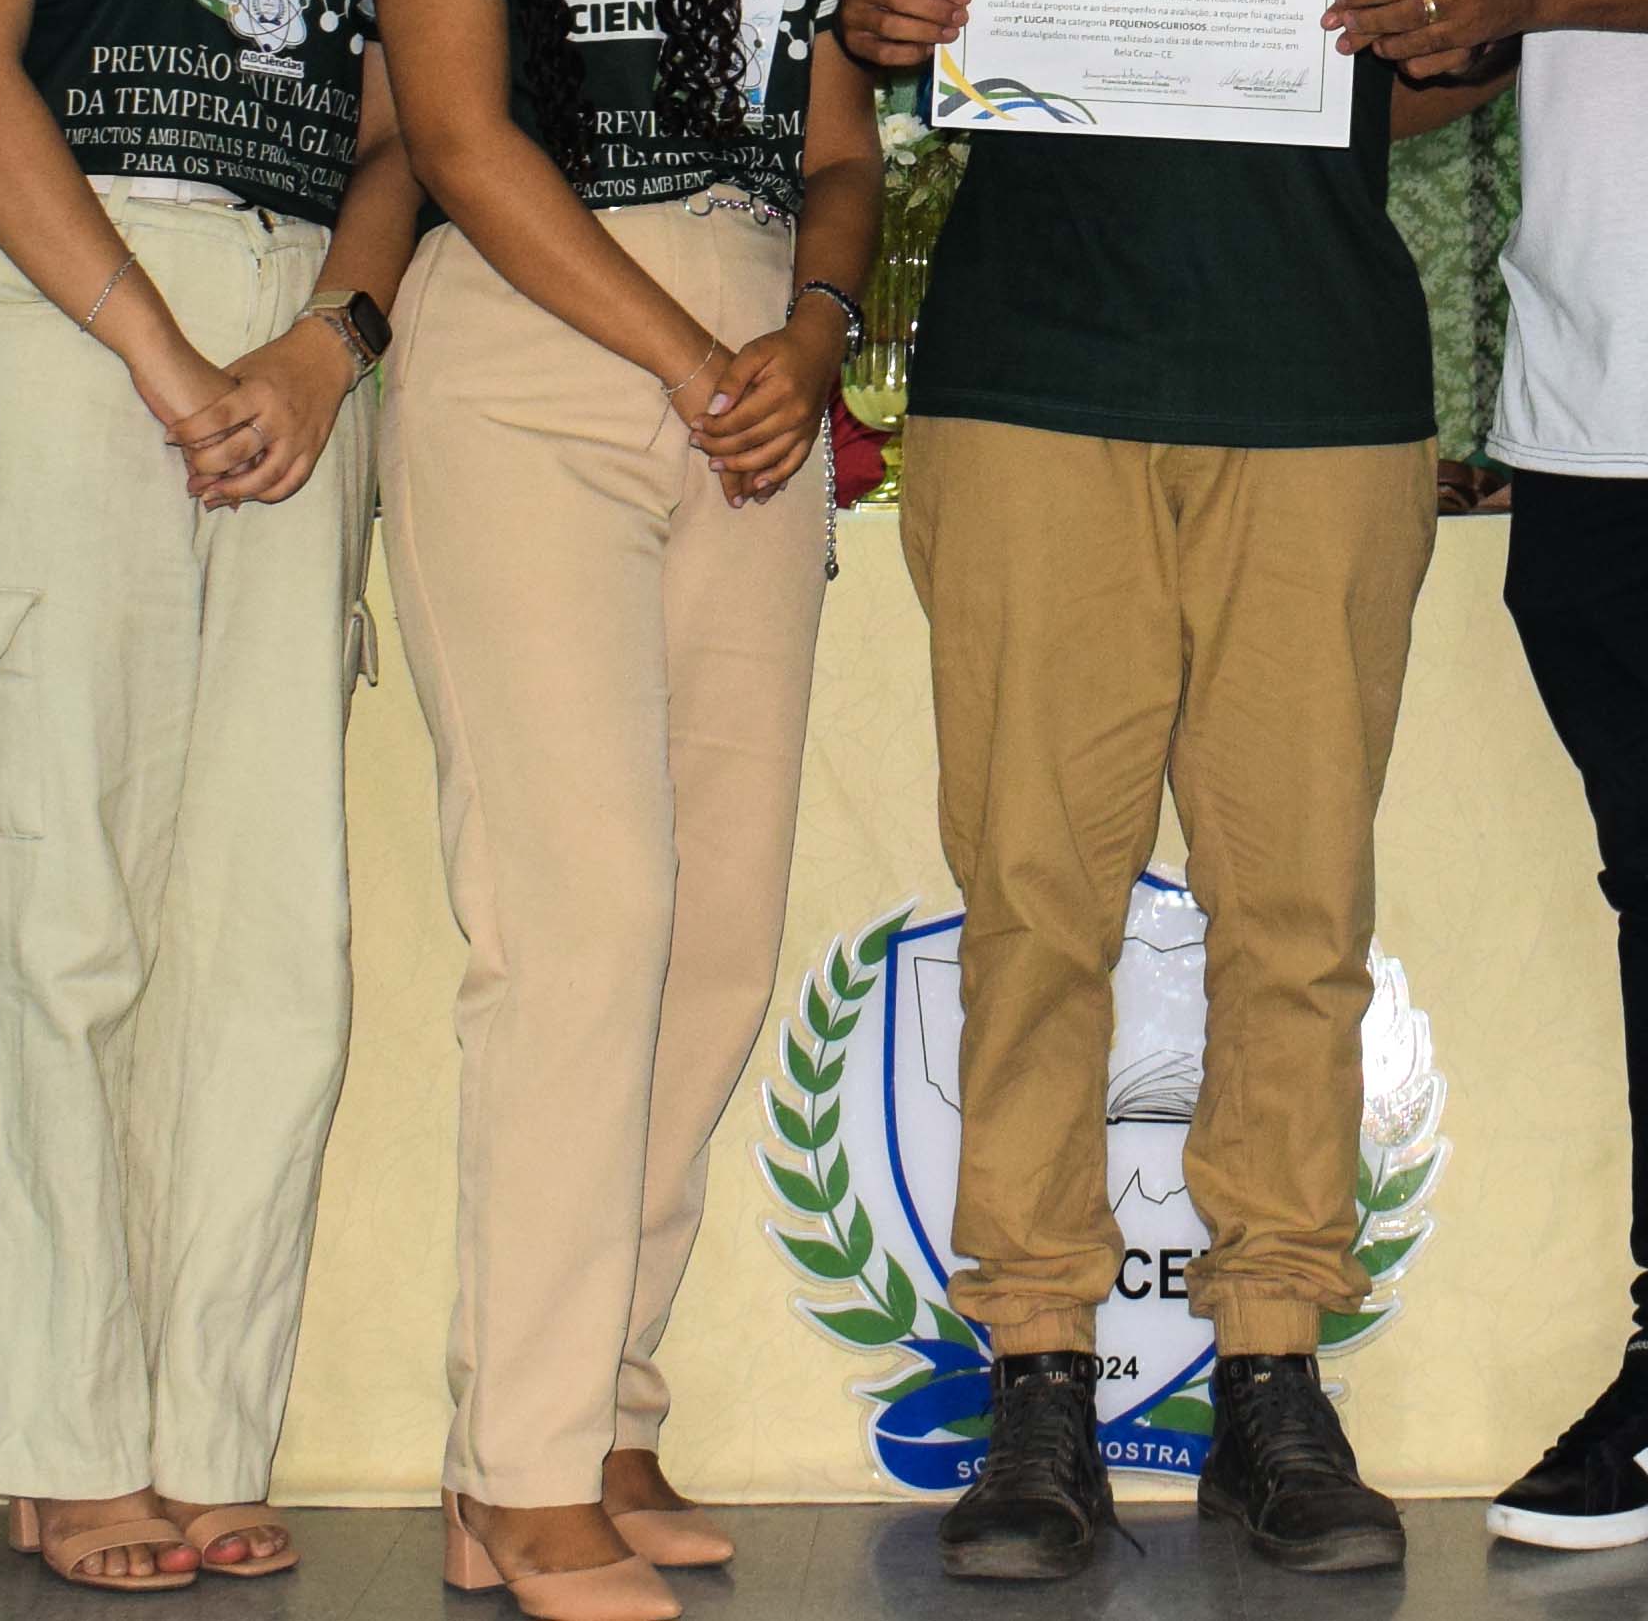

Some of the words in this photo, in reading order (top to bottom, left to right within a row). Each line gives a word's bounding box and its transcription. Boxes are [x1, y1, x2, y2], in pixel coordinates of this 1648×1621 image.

[568, 1, 655, 34] CIEN
[1032, 0, 1042, 10] da
[1044, 1, 1081, 14] proposta
[1102, 3, 1156, 17] desempenho
[1220, 9, 1248, 21] equipe
[1263, 10, 1304, 24] agraciada
[1024, 15, 1055, 25] LUGAR
[1068, 17, 1107, 30] categoria
[1109, 19, 1159, 32] PEQUENOS
[1210, 23, 1252, 34] conforme
[1253, 25, 1297, 36] resultados
[990, 28, 1020, 38] oficiais
[1021, 30, 1067, 43] divulgados
[1114, 34, 1152, 44] realizado
[1166, 36, 1179, 45] dia
[1192, 37, 1203, 46] de
[1204, 38, 1248, 48] novembro
[1249, 40, 1260, 49] de
[241, 52, 303, 70] ABCiências
[1114, 48, 1132, 58] Bela
[1133, 49, 1153, 59] Cruz
[90, 44, 232, 82] PREVISÃO
[240, 74, 359, 123] TEMÁTICA
[65, 88, 105, 116] DA
[114, 87, 293, 148] TEMPERATA
[65, 126, 142, 145] IMPACTOS
[146, 127, 244, 157] AMBIENTAIS
[246, 141, 257, 160] E
[121, 152, 177, 173] PARA
[183, 155, 210, 175] OS
[642, 170, 713, 195] AMBIENT
[1094, 1355, 1139, 1380] 024
[1097, 1441, 1191, 1467] OSTRA
